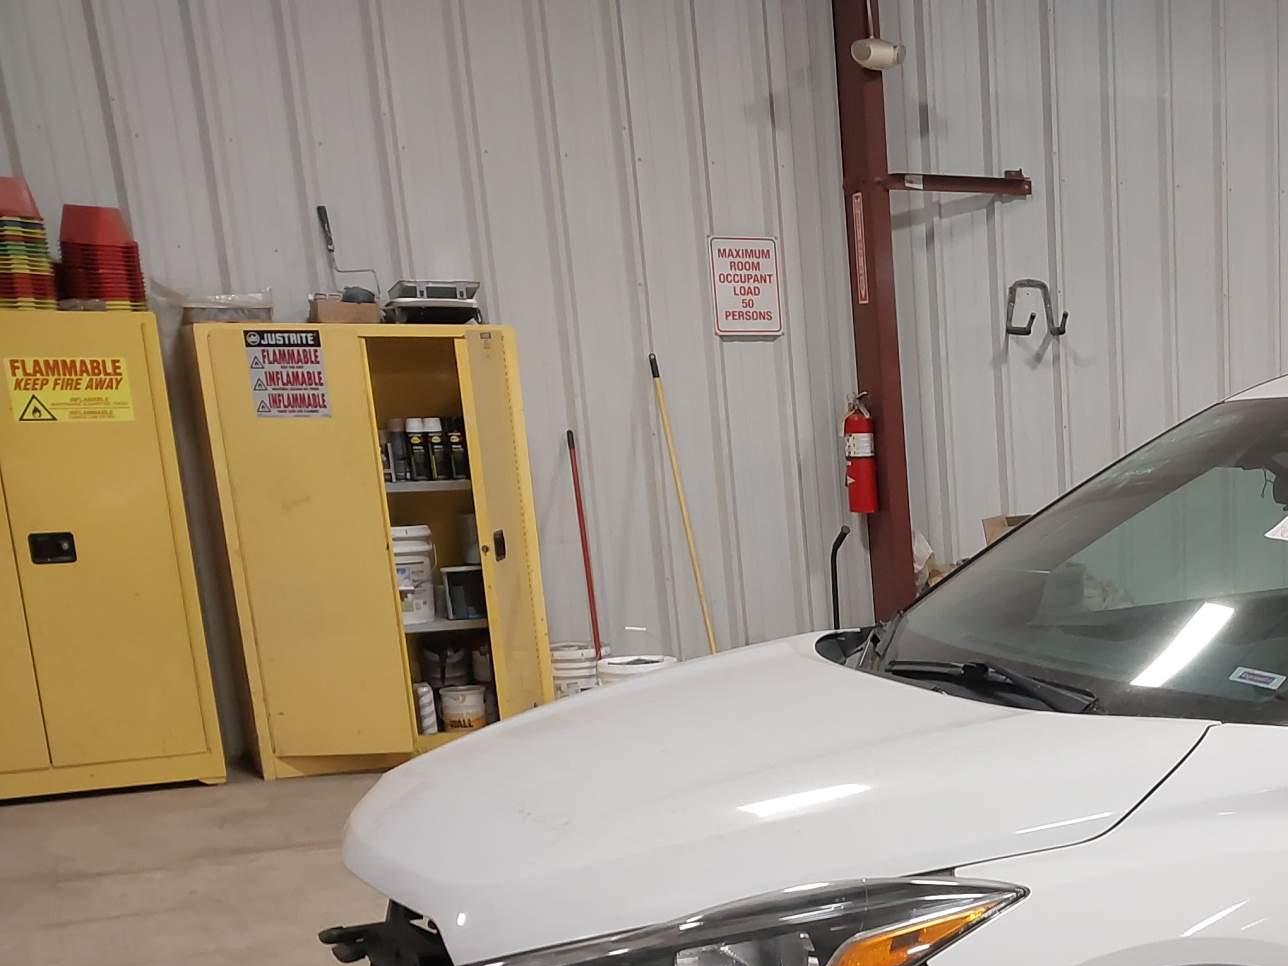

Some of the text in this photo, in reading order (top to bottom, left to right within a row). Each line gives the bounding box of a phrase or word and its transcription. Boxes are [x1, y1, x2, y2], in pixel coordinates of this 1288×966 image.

[717, 247, 771, 259] MAXIMUM
[729, 261, 761, 272] ROOM
[718, 273, 773, 285] OCCUPANT
[733, 286, 761, 297] LOAD
[741, 299, 755, 309] 50
[725, 311, 773, 322] PERSONS
[261, 332, 315, 345] JUSTRITE
[261, 349, 320, 364] FLAMMABLE
[9, 359, 123, 377] FLAMMABLE
[14, 378, 123, 391] KEEP FIRE AWAY
[264, 371, 324, 387] INFLAMABLE
[268, 393, 328, 409] INFLAMMABLE
